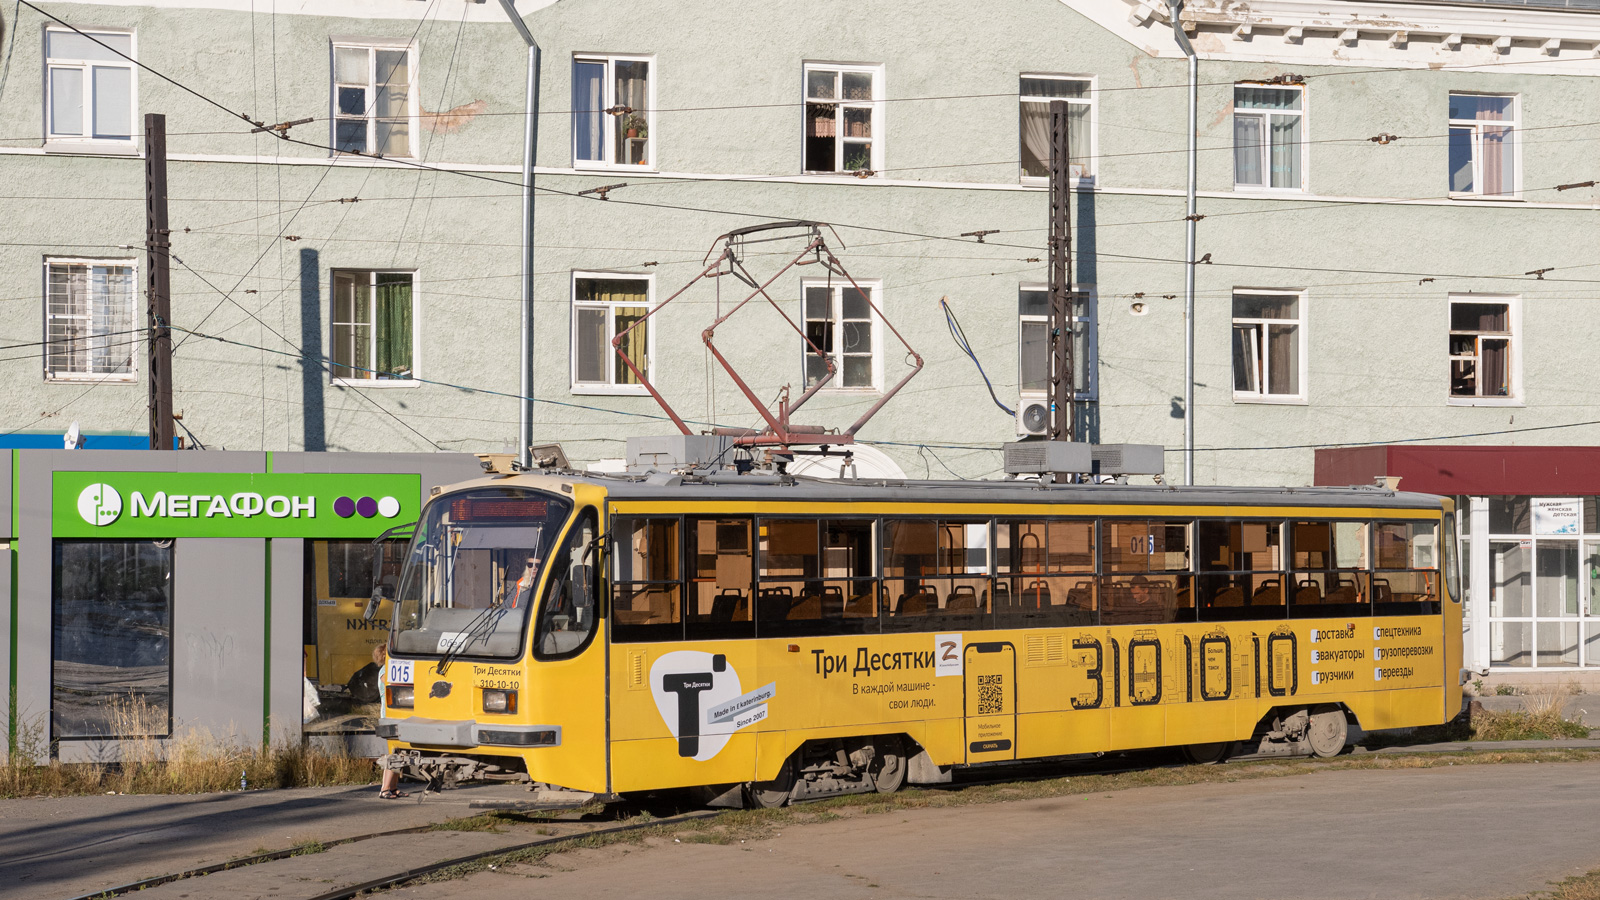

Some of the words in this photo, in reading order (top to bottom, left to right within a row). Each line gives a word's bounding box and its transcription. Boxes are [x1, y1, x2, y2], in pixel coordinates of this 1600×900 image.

[1315, 629, 1354, 642] доставка
[1376, 627, 1421, 639] спецтехника
[940, 641, 958, 661] Z
[1315, 649, 1365, 662] эвакуаторы
[1377, 646, 1433, 661] грузоперевозки
[811, 649, 847, 679] Три
[853, 647, 935, 677] Десятки
[391, 665, 409, 682] 015
[473, 665, 486, 675] Три
[487, 666, 521, 677] Десятки
[1315, 670, 1354, 684] грузчики
[1378, 666, 1413, 680] переезды
[480, 679, 519, 690] 310-10-10
[852, 683, 859, 695] В
[861, 681, 894, 696] каждой
[896, 682, 930, 693] машине
[888, 700, 908, 710] свои
[910, 698, 936, 709] люди.
[713, 708, 729, 719] Made
[729, 704, 736, 712] in
[736, 717, 752, 728] Since
[752, 710, 766, 721] 2007
